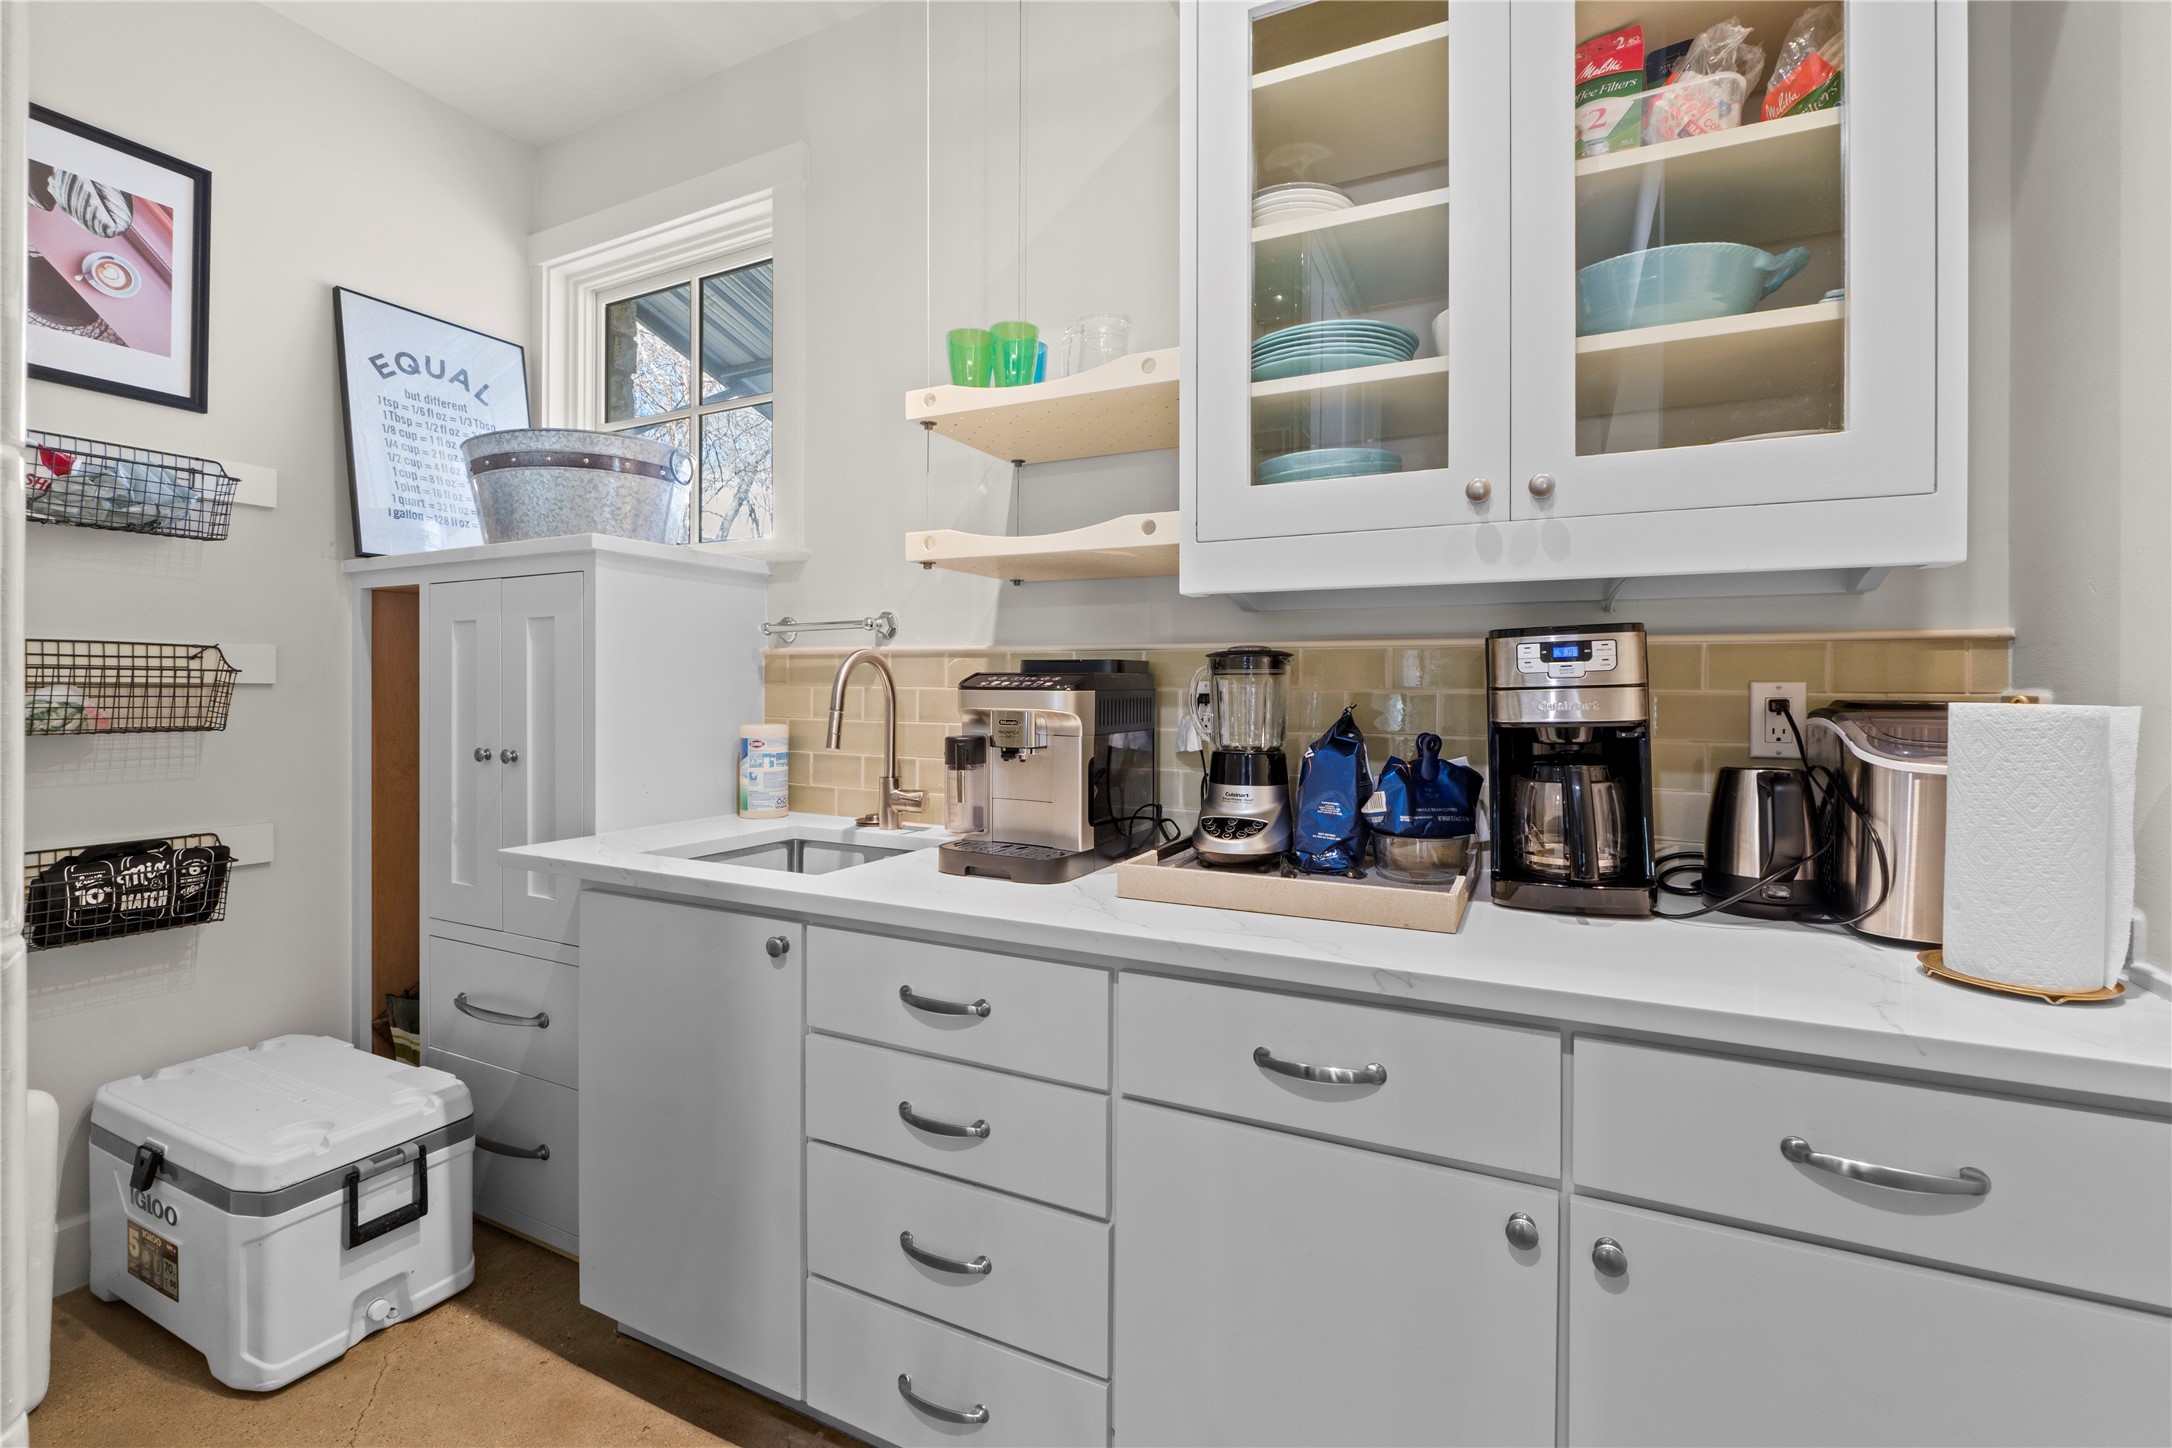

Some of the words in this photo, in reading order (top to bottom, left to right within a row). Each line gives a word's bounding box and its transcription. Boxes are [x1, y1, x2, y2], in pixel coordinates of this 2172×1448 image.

[1575, 57, 1622, 80] Melitta
[1599, 78, 1637, 95] Filters
[368, 351, 490, 407] EQUAL
[383, 396, 398, 410] tsp
[412, 405, 426, 416] 1/6
[427, 408, 434, 418] fl
[436, 413, 447, 422] oz
[459, 416, 472, 427] 1/3
[404, 388, 421, 402] but
[424, 394, 468, 413] different
[388, 410, 412, 428] Tbsp
[425, 422, 438, 432] 1/2
[440, 424, 447, 434] fl
[449, 428, 460, 437] oz
[382, 424, 396, 435] 1/8
[398, 428, 418, 442] cup
[437, 436, 444, 447] fl
[446, 440, 456, 449] oz
[384, 438, 398, 449] 1/4
[401, 442, 420, 456] cup
[432, 450, 437, 458] 2
[439, 450, 446, 460] fl
[448, 454, 458, 462] oz
[388, 452, 402, 464] 1/2
[404, 457, 422, 470] cup
[434, 462, 440, 472] 4
[442, 464, 448, 474] fl
[450, 467, 461, 476] oz
[399, 470, 418, 481] cup
[430, 475, 434, 484] 8
[437, 476, 444, 486] fl
[446, 480, 456, 488] oz
[401, 482, 420, 494] pint
[432, 488, 442, 498] 16
[444, 490, 450, 500] fl
[452, 494, 464, 502] oz
[398, 496, 426, 508] quart
[437, 502, 448, 512] 32
[450, 504, 456, 514] fl
[458, 508, 470, 516] oz
[393, 508, 424, 521] gallon
[434, 514, 449, 526] 128
[451, 518, 458, 526] fl
[460, 520, 470, 528] oz
[1537, 701, 1600, 712] Cuisinart
[188, 862, 201, 875] 6
[120, 890, 168, 911] MATCH
[130, 1186, 178, 1226] IGLOO
